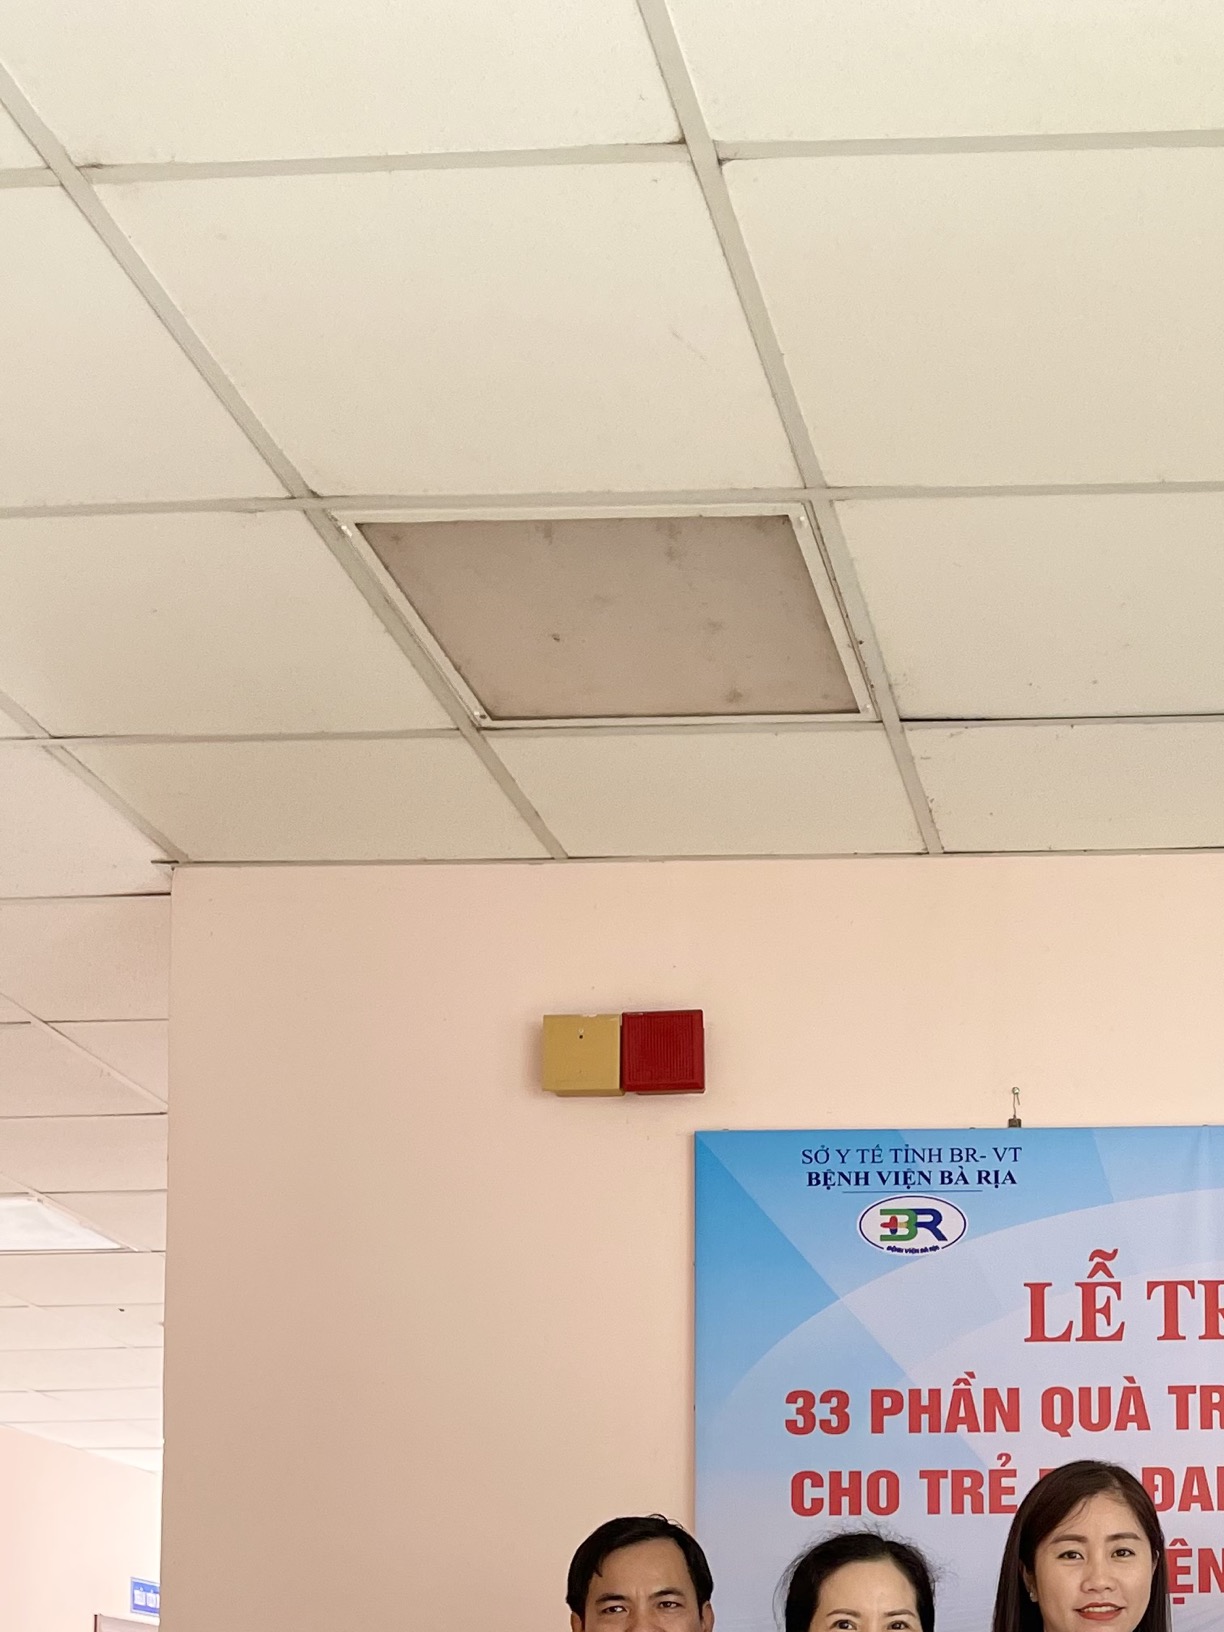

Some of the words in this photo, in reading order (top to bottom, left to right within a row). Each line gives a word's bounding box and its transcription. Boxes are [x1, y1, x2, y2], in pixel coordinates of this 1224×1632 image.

[802, 1145, 829, 1164] SỞ
[836, 1149, 850, 1163] Y
[857, 1144, 883, 1163] TẾ
[890, 1144, 942, 1163] TỈNH
[950, 1148, 986, 1162] BR-
[993, 1147, 1022, 1162] VT
[808, 1169, 869, 1190] BỆNH
[877, 1171, 931, 1189] VIỆN
[941, 1166, 969, 1184] BÀ
[978, 1170, 1016, 1188] RỊA
[1024, 1248, 1125, 1343] LỄ
[786, 1390, 849, 1435] 33
[871, 1372, 1020, 1433] PHẦN
[1041, 1376, 1150, 1437] QUÀ
[791, 1470, 899, 1516] CHO
[920, 1453, 1018, 1514] TRẺ
